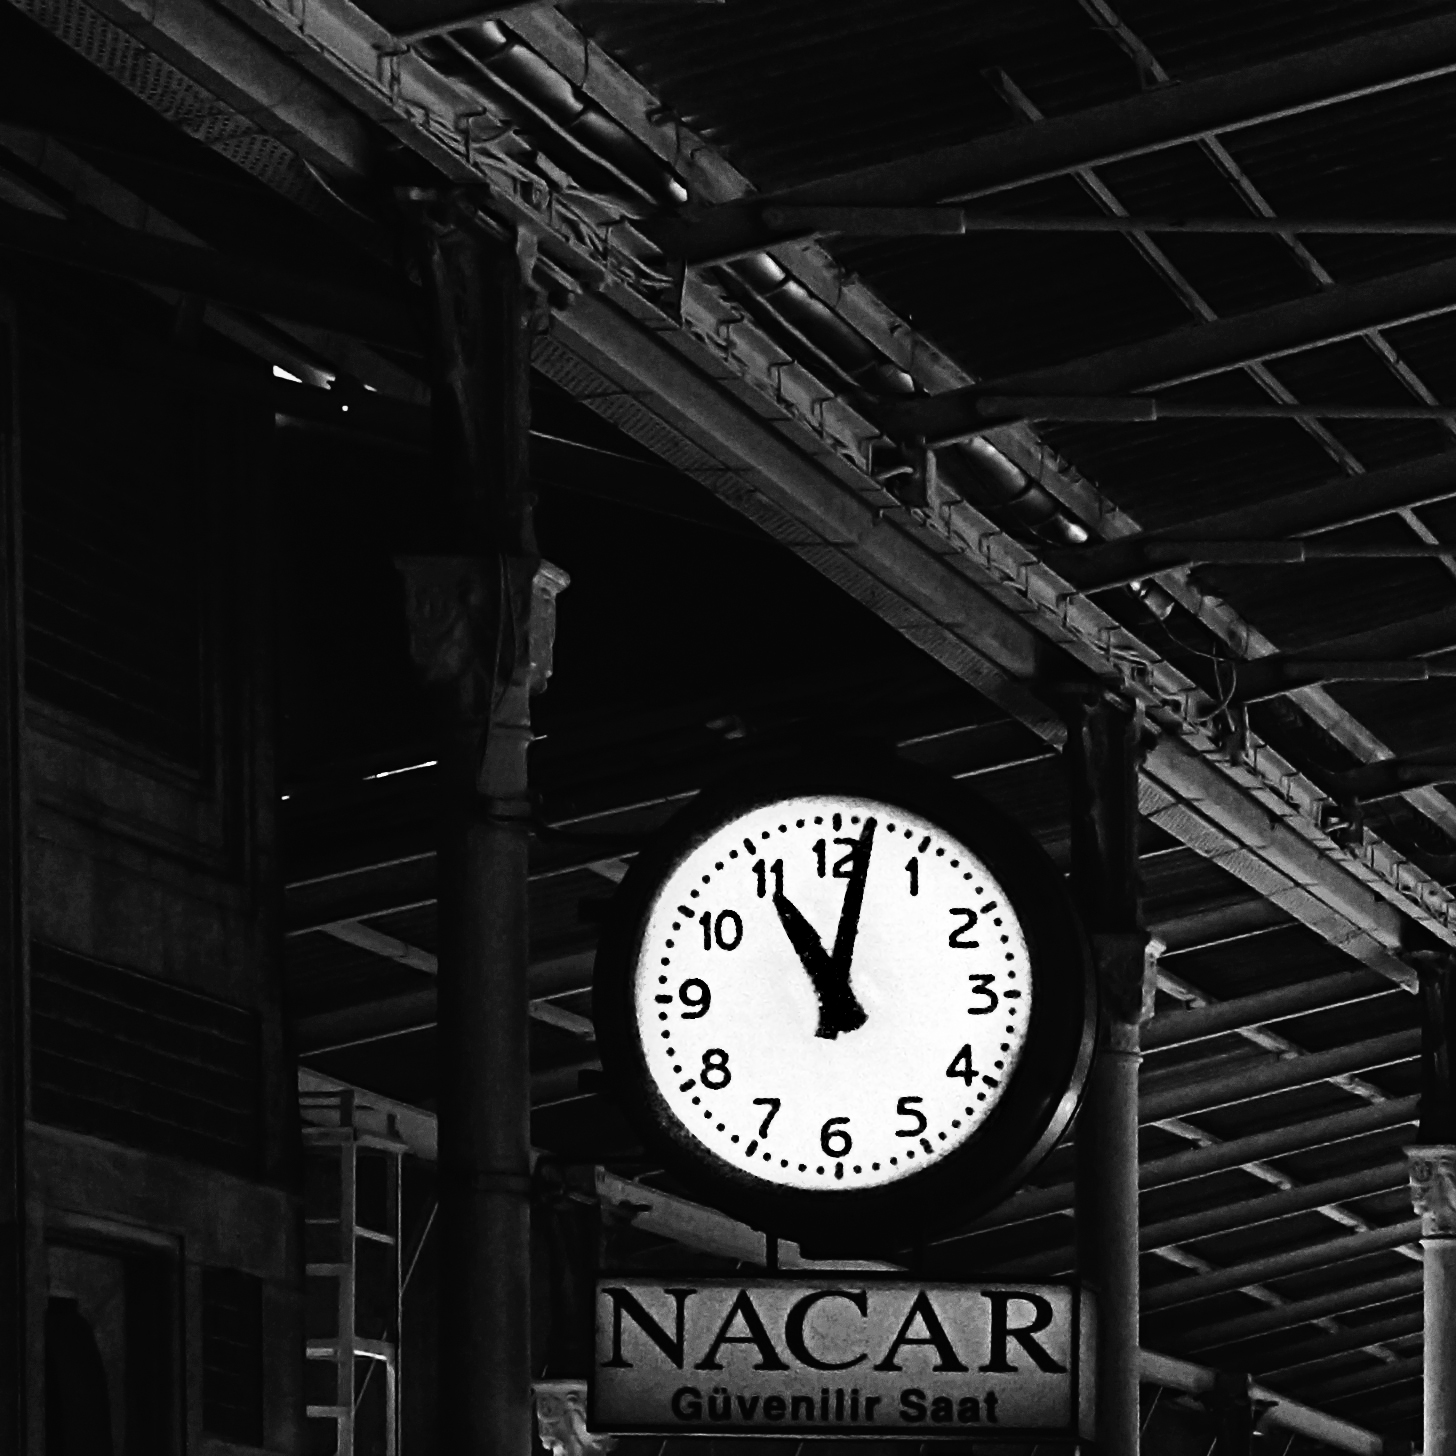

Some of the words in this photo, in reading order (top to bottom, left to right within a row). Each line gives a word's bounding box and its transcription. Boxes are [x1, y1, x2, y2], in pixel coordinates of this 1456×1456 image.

[751, 858, 784, 899] 11
[811, 837, 864, 879] 12
[904, 856, 919, 897] 1
[698, 908, 744, 952] 10
[948, 907, 980, 949] 2
[678, 977, 712, 1020] 9
[967, 973, 999, 1016] 3
[699, 1047, 732, 1091] 8
[945, 1043, 980, 1087] 4
[752, 1097, 782, 1140] 7
[820, 1116, 853, 1159] 6
[894, 1095, 928, 1138] 5
[600, 1287, 1068, 1374] NACAR
[670, 1386, 881, 1423] Güvenilir
[899, 1387, 999, 1424] Saat
